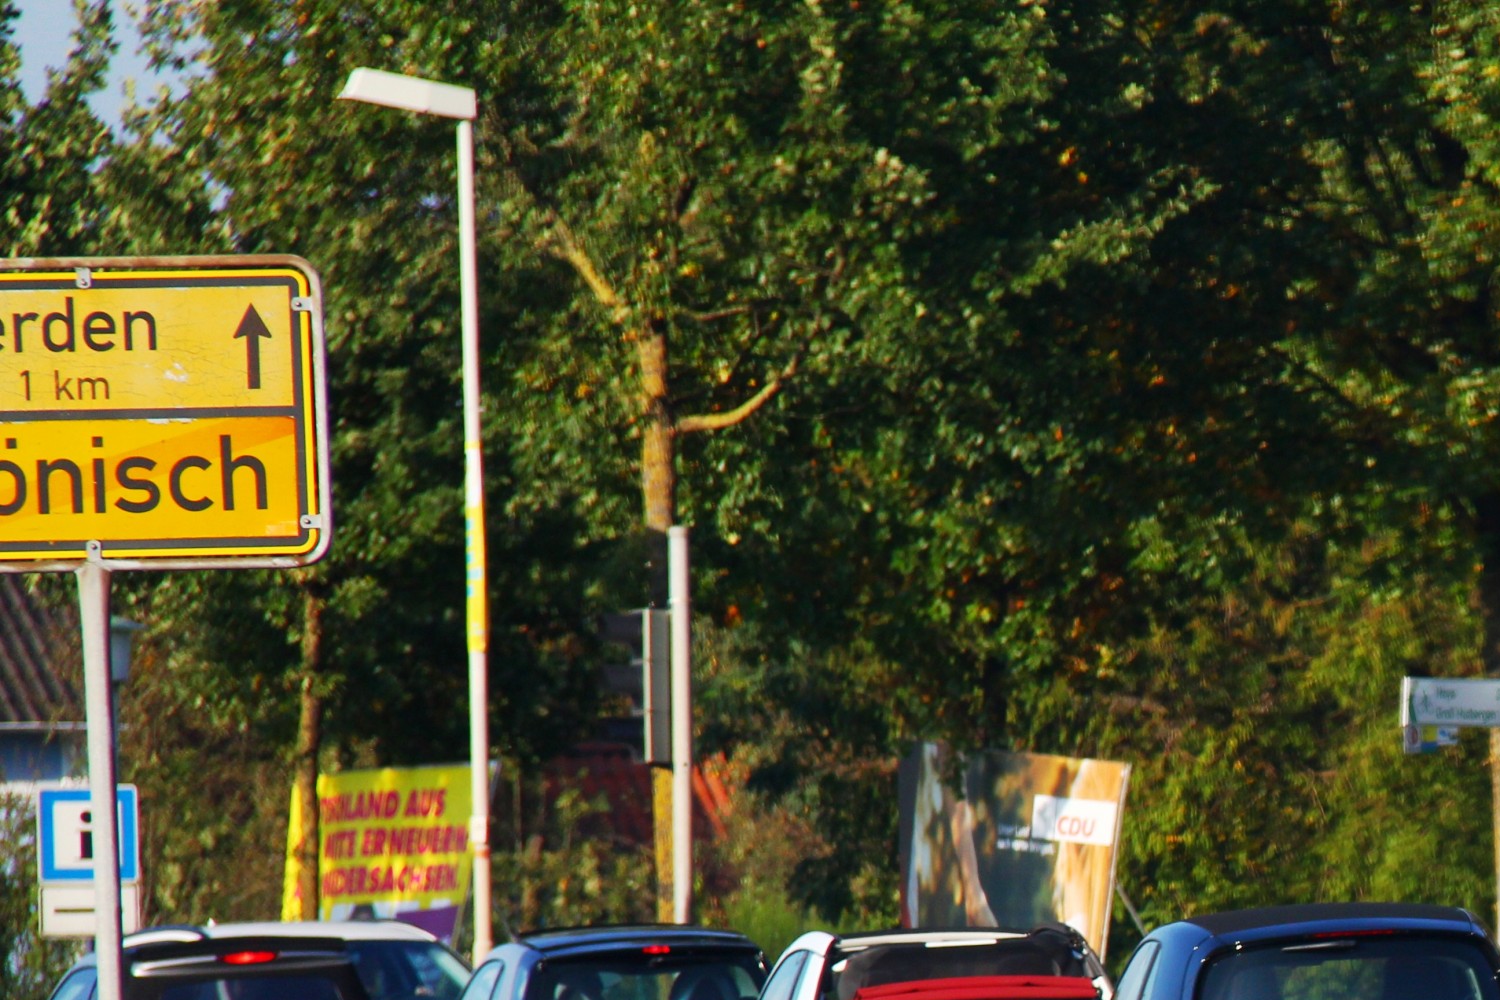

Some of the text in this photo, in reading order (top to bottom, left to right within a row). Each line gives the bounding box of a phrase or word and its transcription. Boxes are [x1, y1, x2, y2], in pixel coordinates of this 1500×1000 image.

[0, 297, 157, 353] rden
[55, 369, 110, 400] km
[405, 788, 447, 817] AUS
[1058, 817, 1095, 836] CDU
